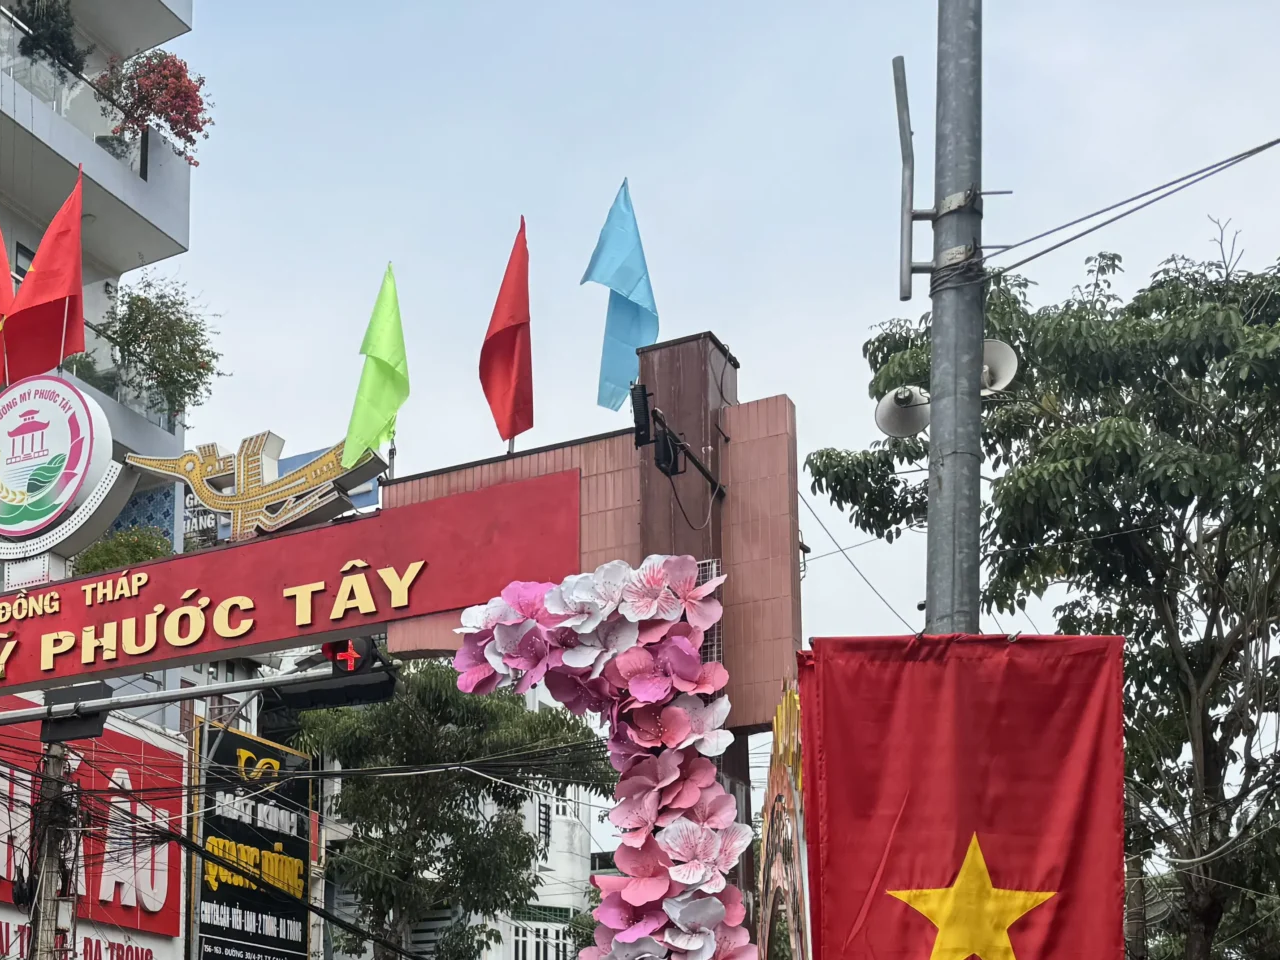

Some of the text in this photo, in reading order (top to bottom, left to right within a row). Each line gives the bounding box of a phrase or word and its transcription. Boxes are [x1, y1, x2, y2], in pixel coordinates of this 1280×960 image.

[20, 389, 31, 404] MỸ
[33, 389, 60, 404] PHƯỚC
[58, 397, 73, 414] TÂY
[81, 569, 149, 606] THÁP
[40, 588, 256, 672] PHƯỚC
[282, 558, 426, 626] TÂY
[225, 947, 244, 959] ĐƯỜNG
